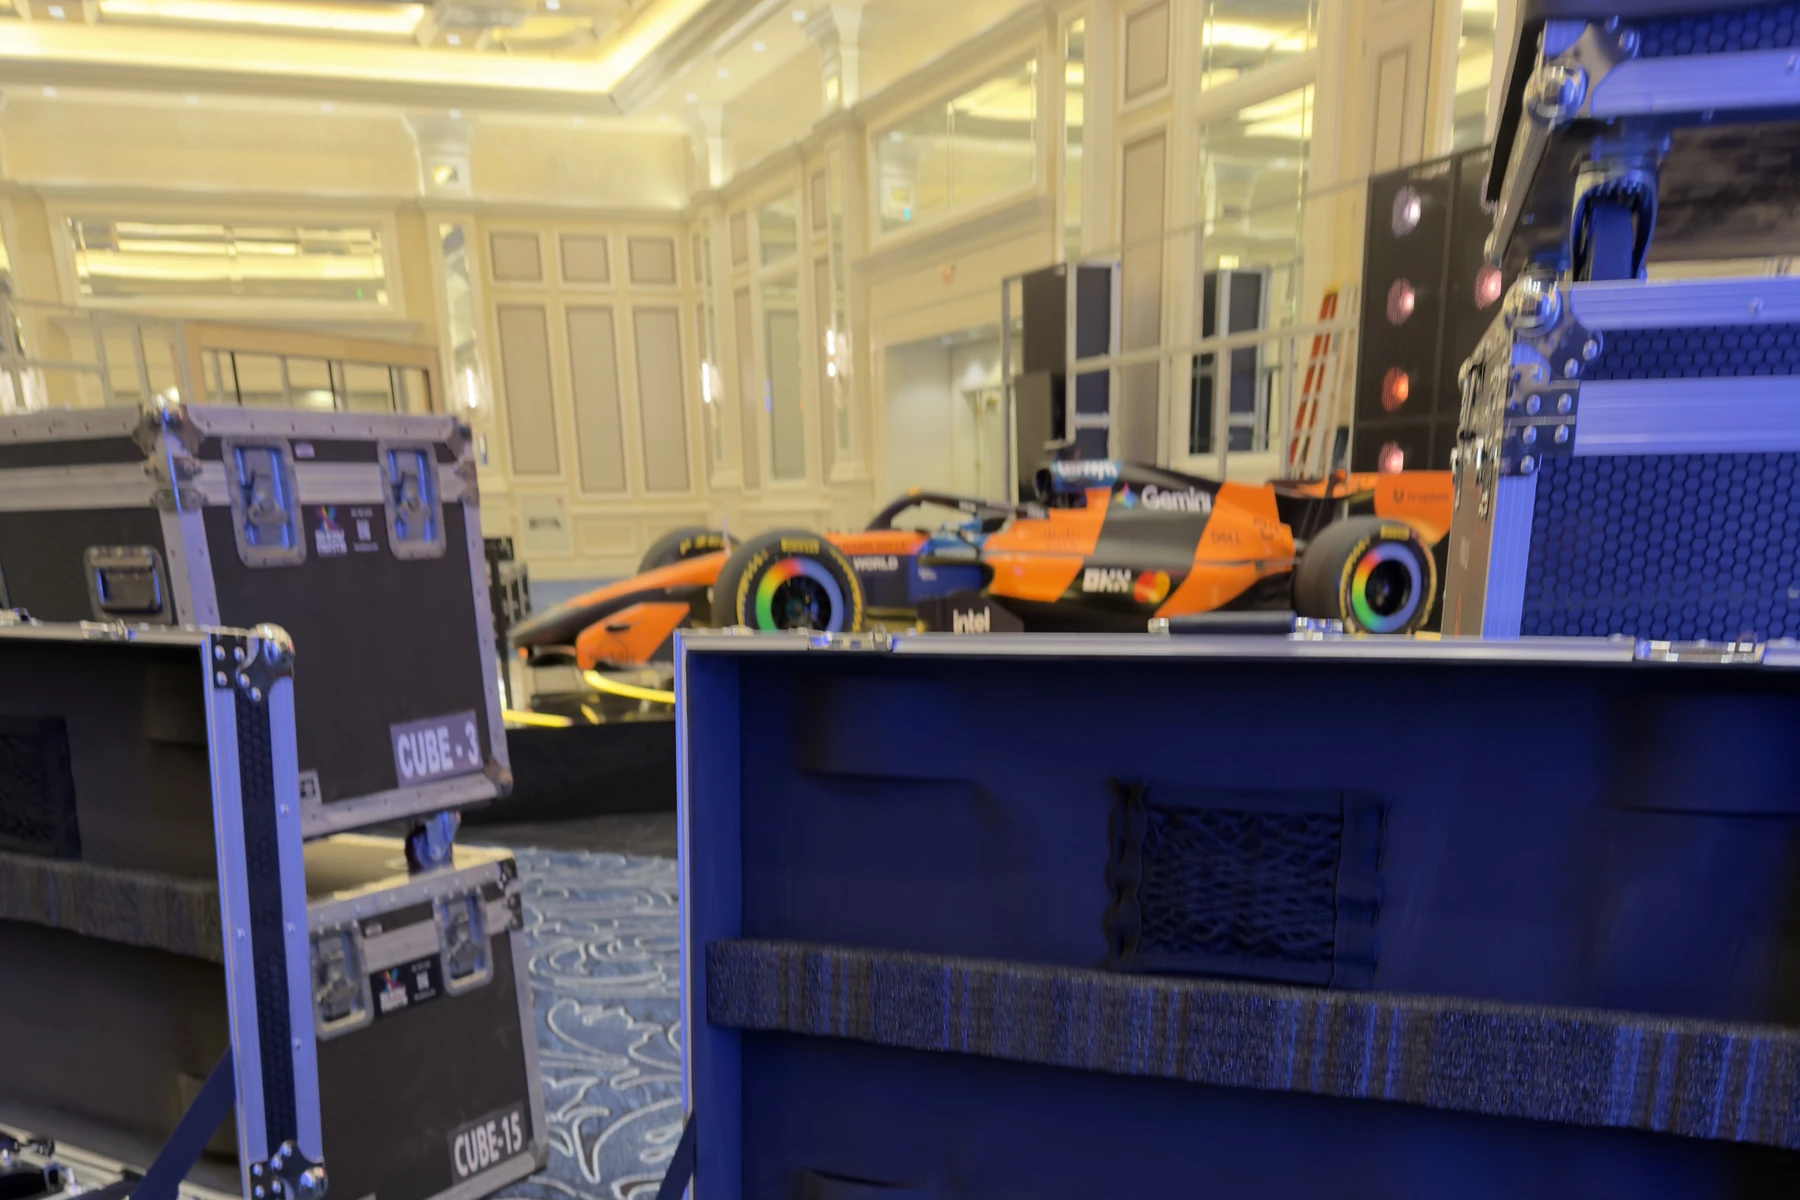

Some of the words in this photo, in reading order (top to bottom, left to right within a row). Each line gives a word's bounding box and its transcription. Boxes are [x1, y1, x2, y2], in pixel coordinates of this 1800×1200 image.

[1141, 484, 1212, 512] Gemini
[853, 555, 899, 572] WORLD
[397, 726, 454, 779] CUBE
[465, 720, 479, 766] 3
[454, 1110, 522, 1177] CUBE-15
